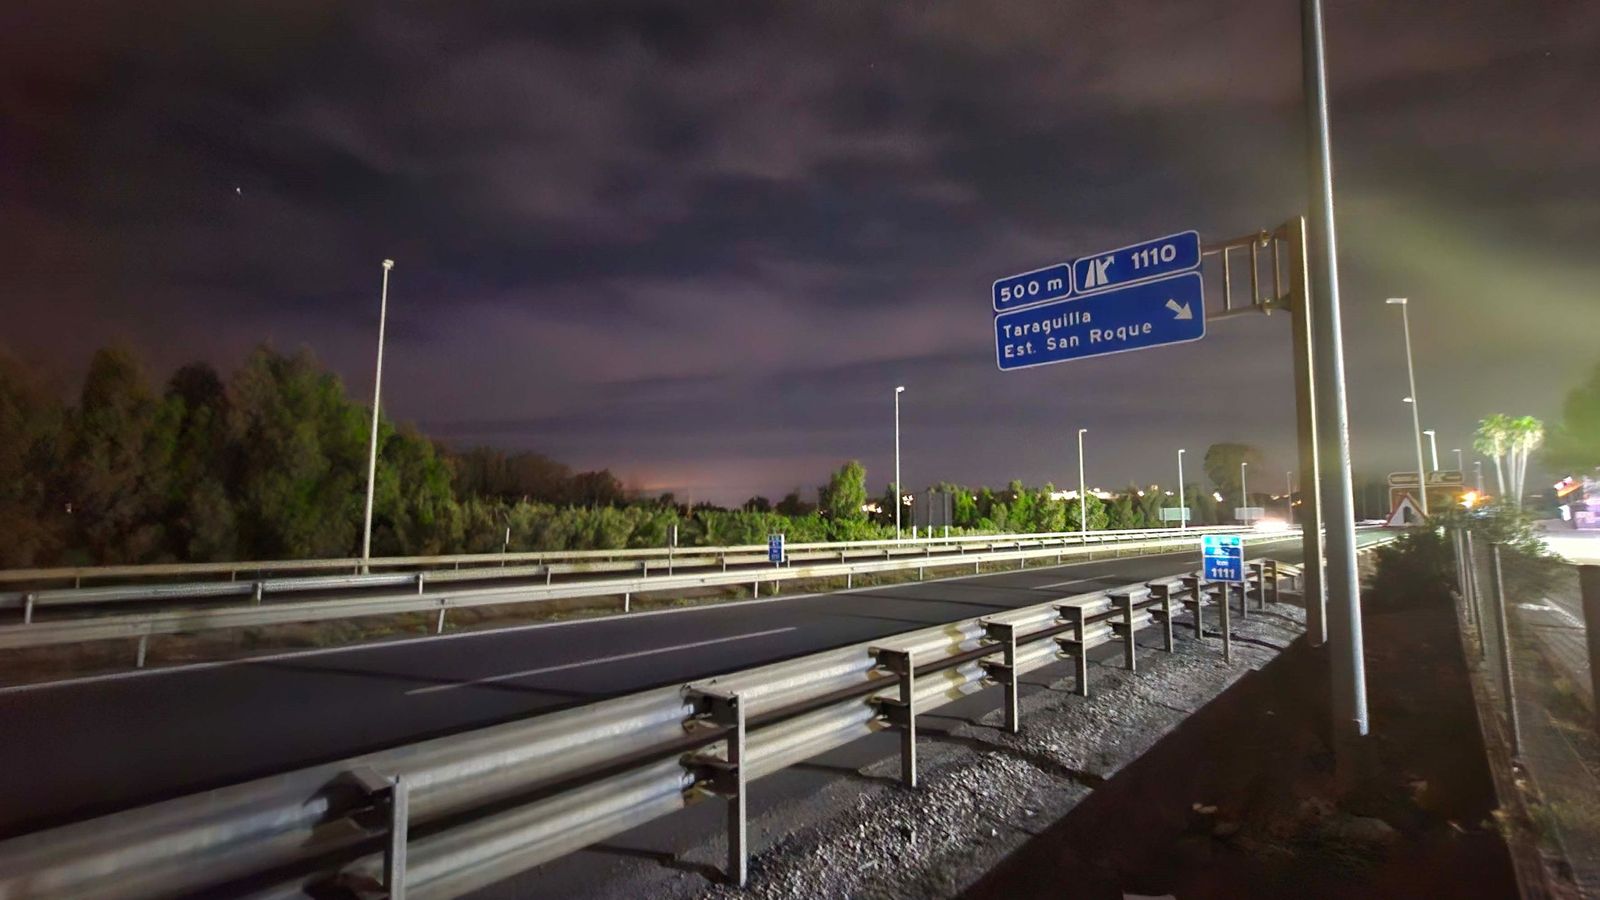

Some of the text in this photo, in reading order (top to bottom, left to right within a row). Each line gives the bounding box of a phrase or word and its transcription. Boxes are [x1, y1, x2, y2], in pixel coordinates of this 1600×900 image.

[1131, 244, 1177, 269] 1110
[1001, 278, 1063, 302] 500 m
[1003, 311, 1092, 338] Taraguilla
[1004, 321, 1152, 358] Est. San Roque
[1211, 568, 1235, 578] 1111
